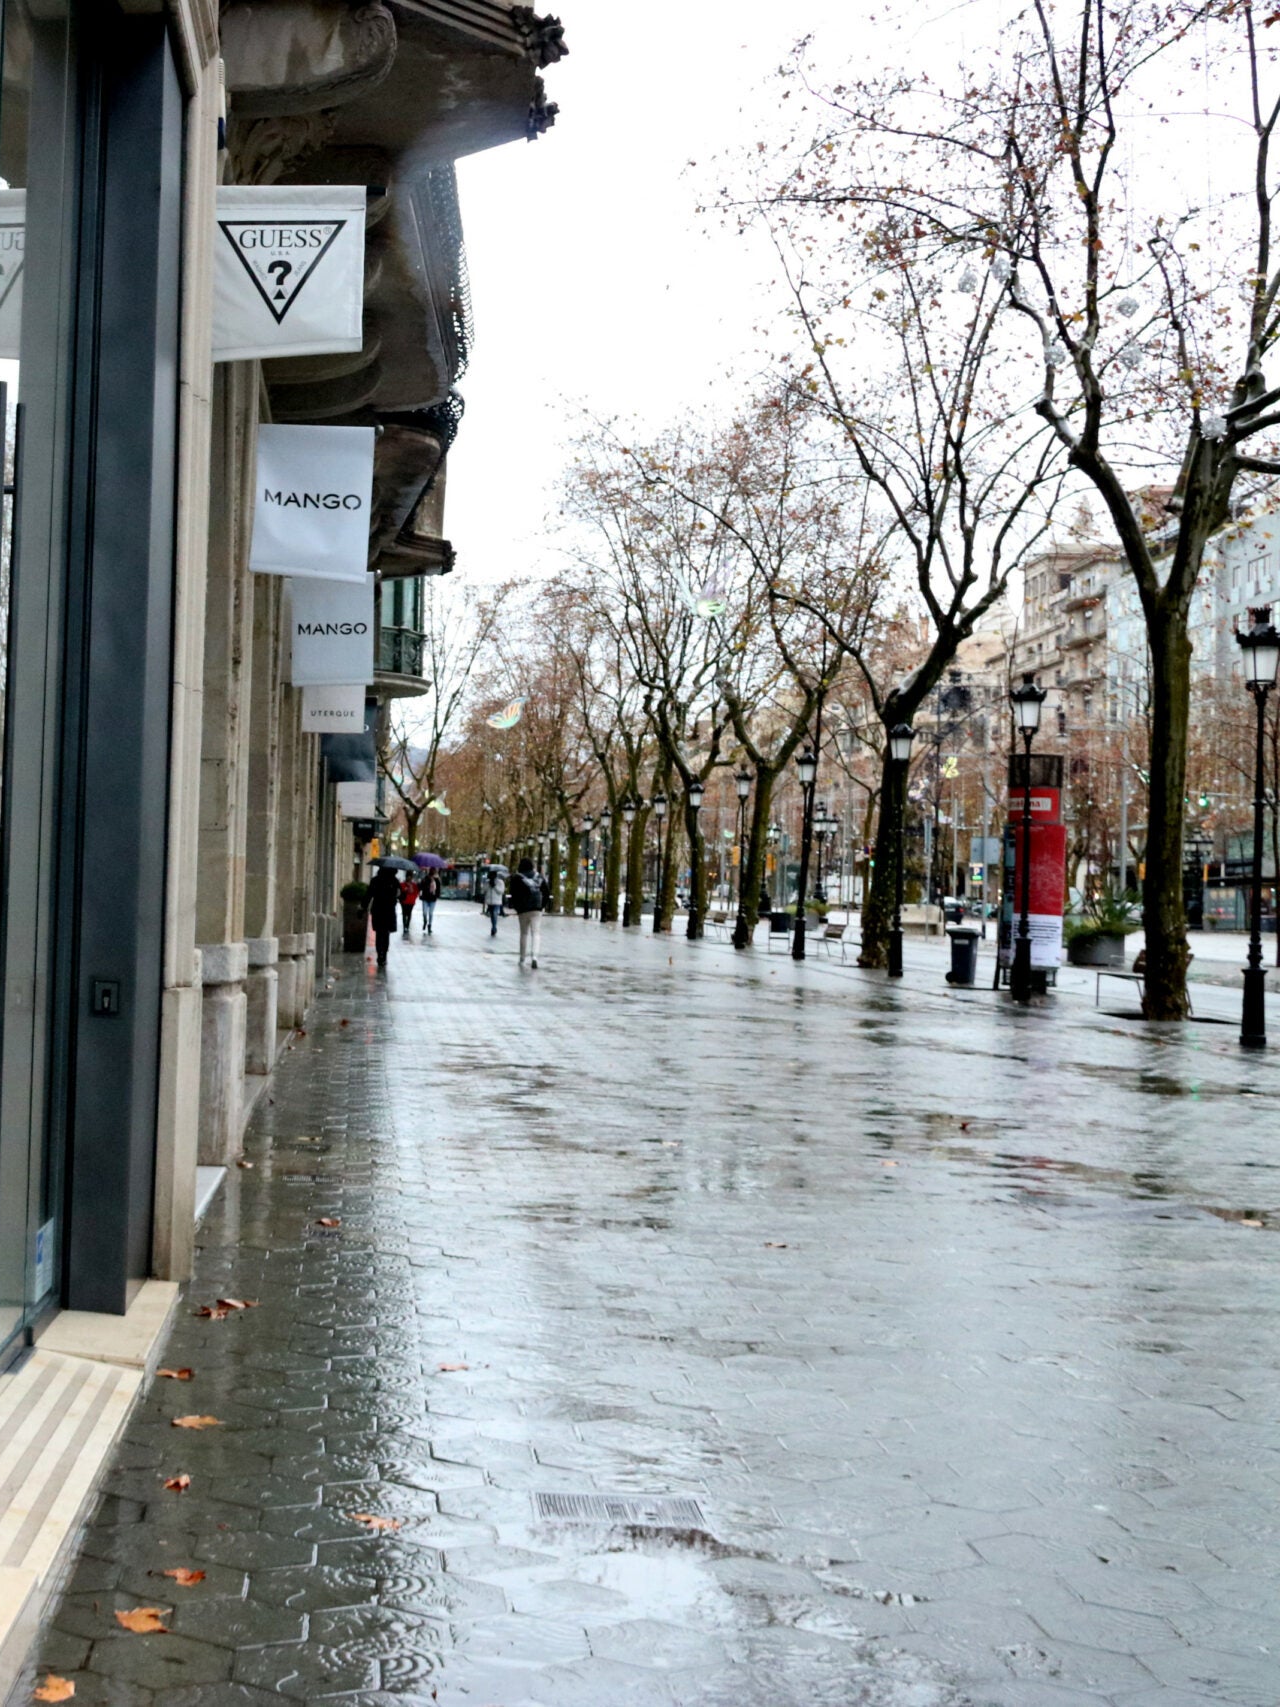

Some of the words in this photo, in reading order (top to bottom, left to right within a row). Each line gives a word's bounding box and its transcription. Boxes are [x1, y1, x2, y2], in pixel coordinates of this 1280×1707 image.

[239, 228, 322, 249] GUESS
[264, 488, 362, 511] MANGO
[297, 622, 368, 636] MANGO
